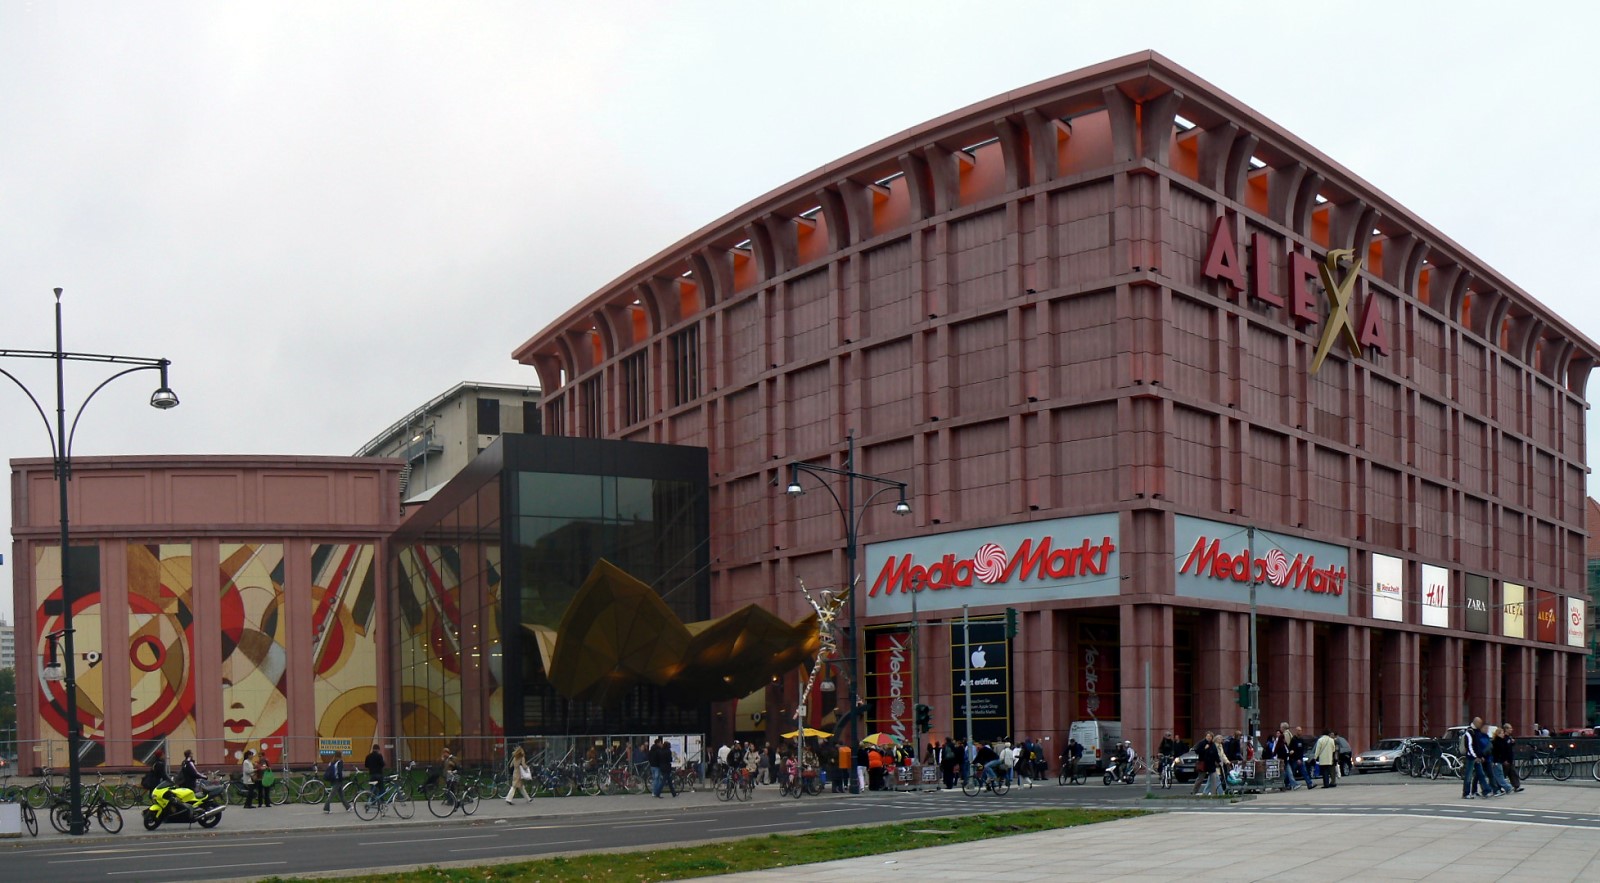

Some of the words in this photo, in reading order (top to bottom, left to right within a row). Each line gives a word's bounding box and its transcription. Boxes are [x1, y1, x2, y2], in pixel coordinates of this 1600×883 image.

[1201, 216, 1389, 374] ALEXA
[868, 553, 975, 597] Media
[996, 536, 1115, 584] Markt
[1178, 536, 1267, 583] Meda
[1283, 553, 1347, 596] Markt
[1426, 583, 1444, 608] H&M
[1467, 597, 1486, 612] ZARA
[1504, 602, 1524, 622] ALEXA
[1537, 608, 1556, 629] ALEXA
[890, 635, 905, 697] Media
